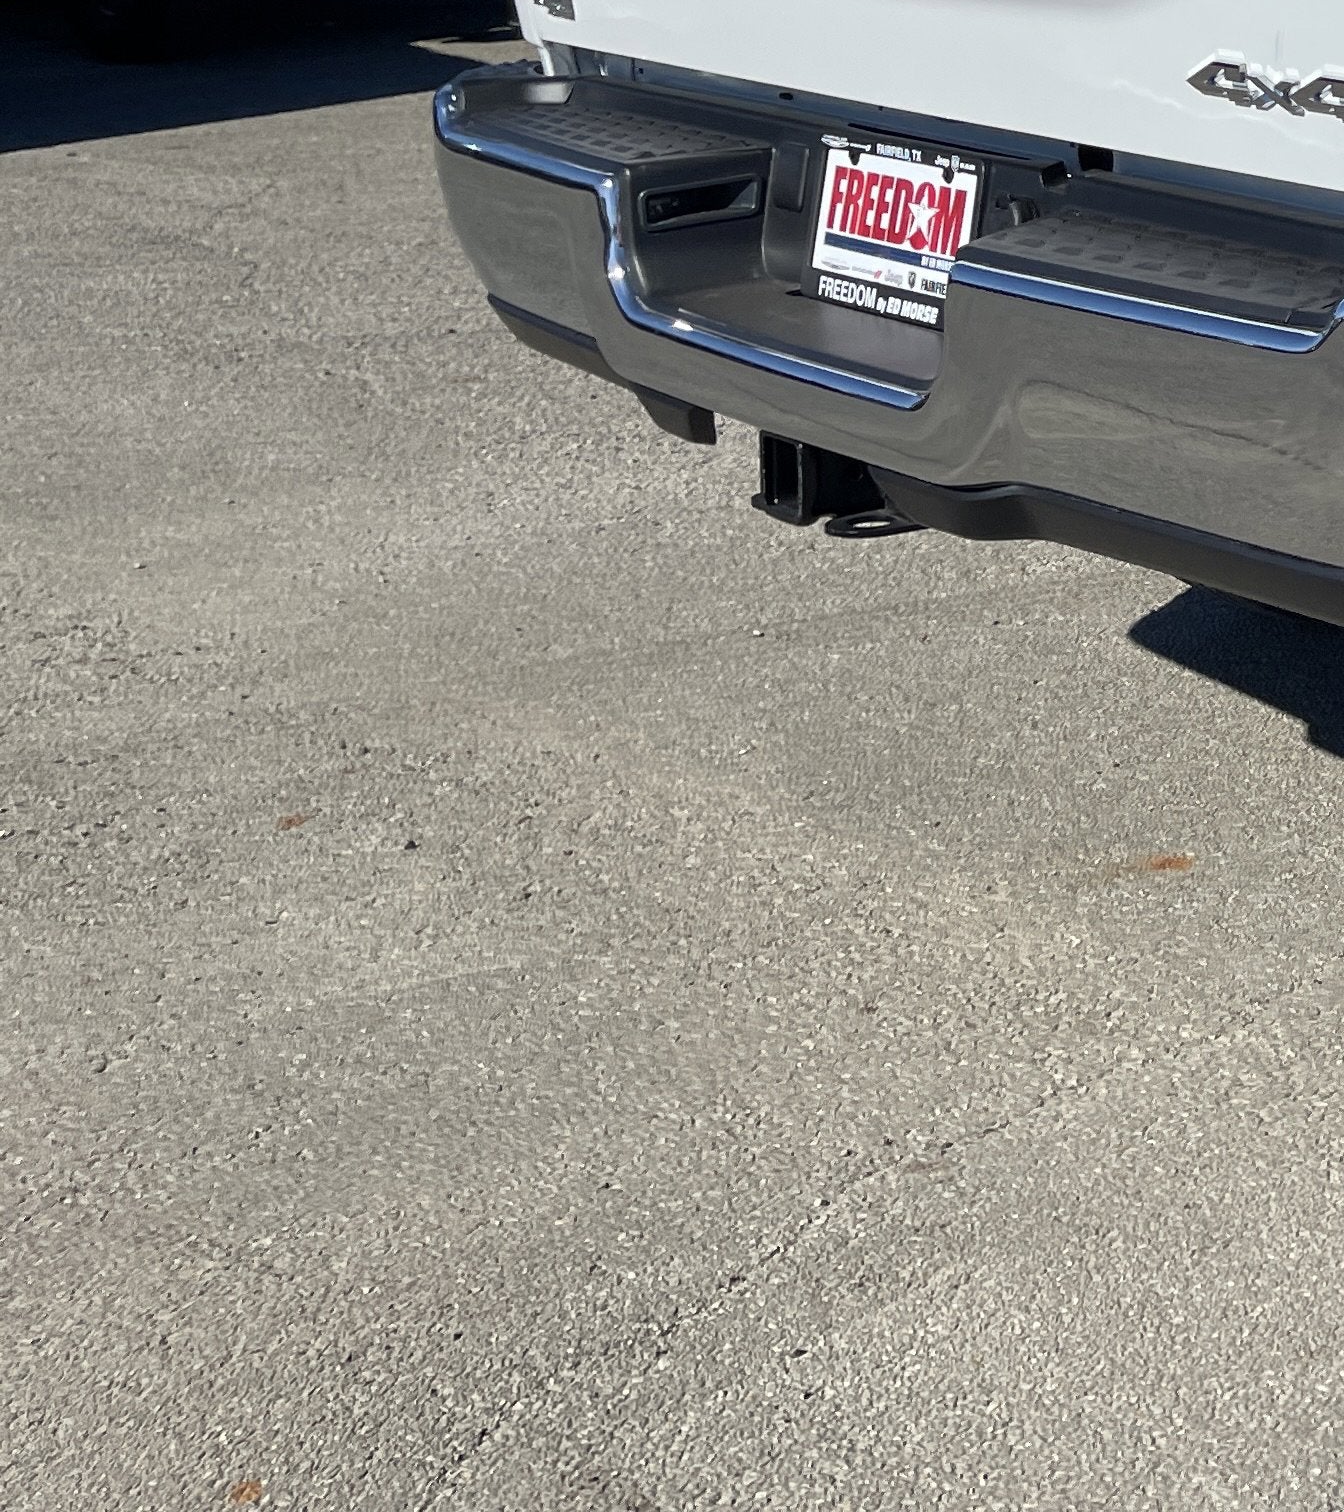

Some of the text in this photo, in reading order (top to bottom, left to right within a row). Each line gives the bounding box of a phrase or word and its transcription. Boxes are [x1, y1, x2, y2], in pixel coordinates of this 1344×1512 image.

[911, 149, 922, 162] TX
[826, 165, 968, 260] FREEDOM
[817, 275, 878, 309] FREEDOM
[886, 296, 902, 315] ED
[900, 300, 939, 325] MORSE
